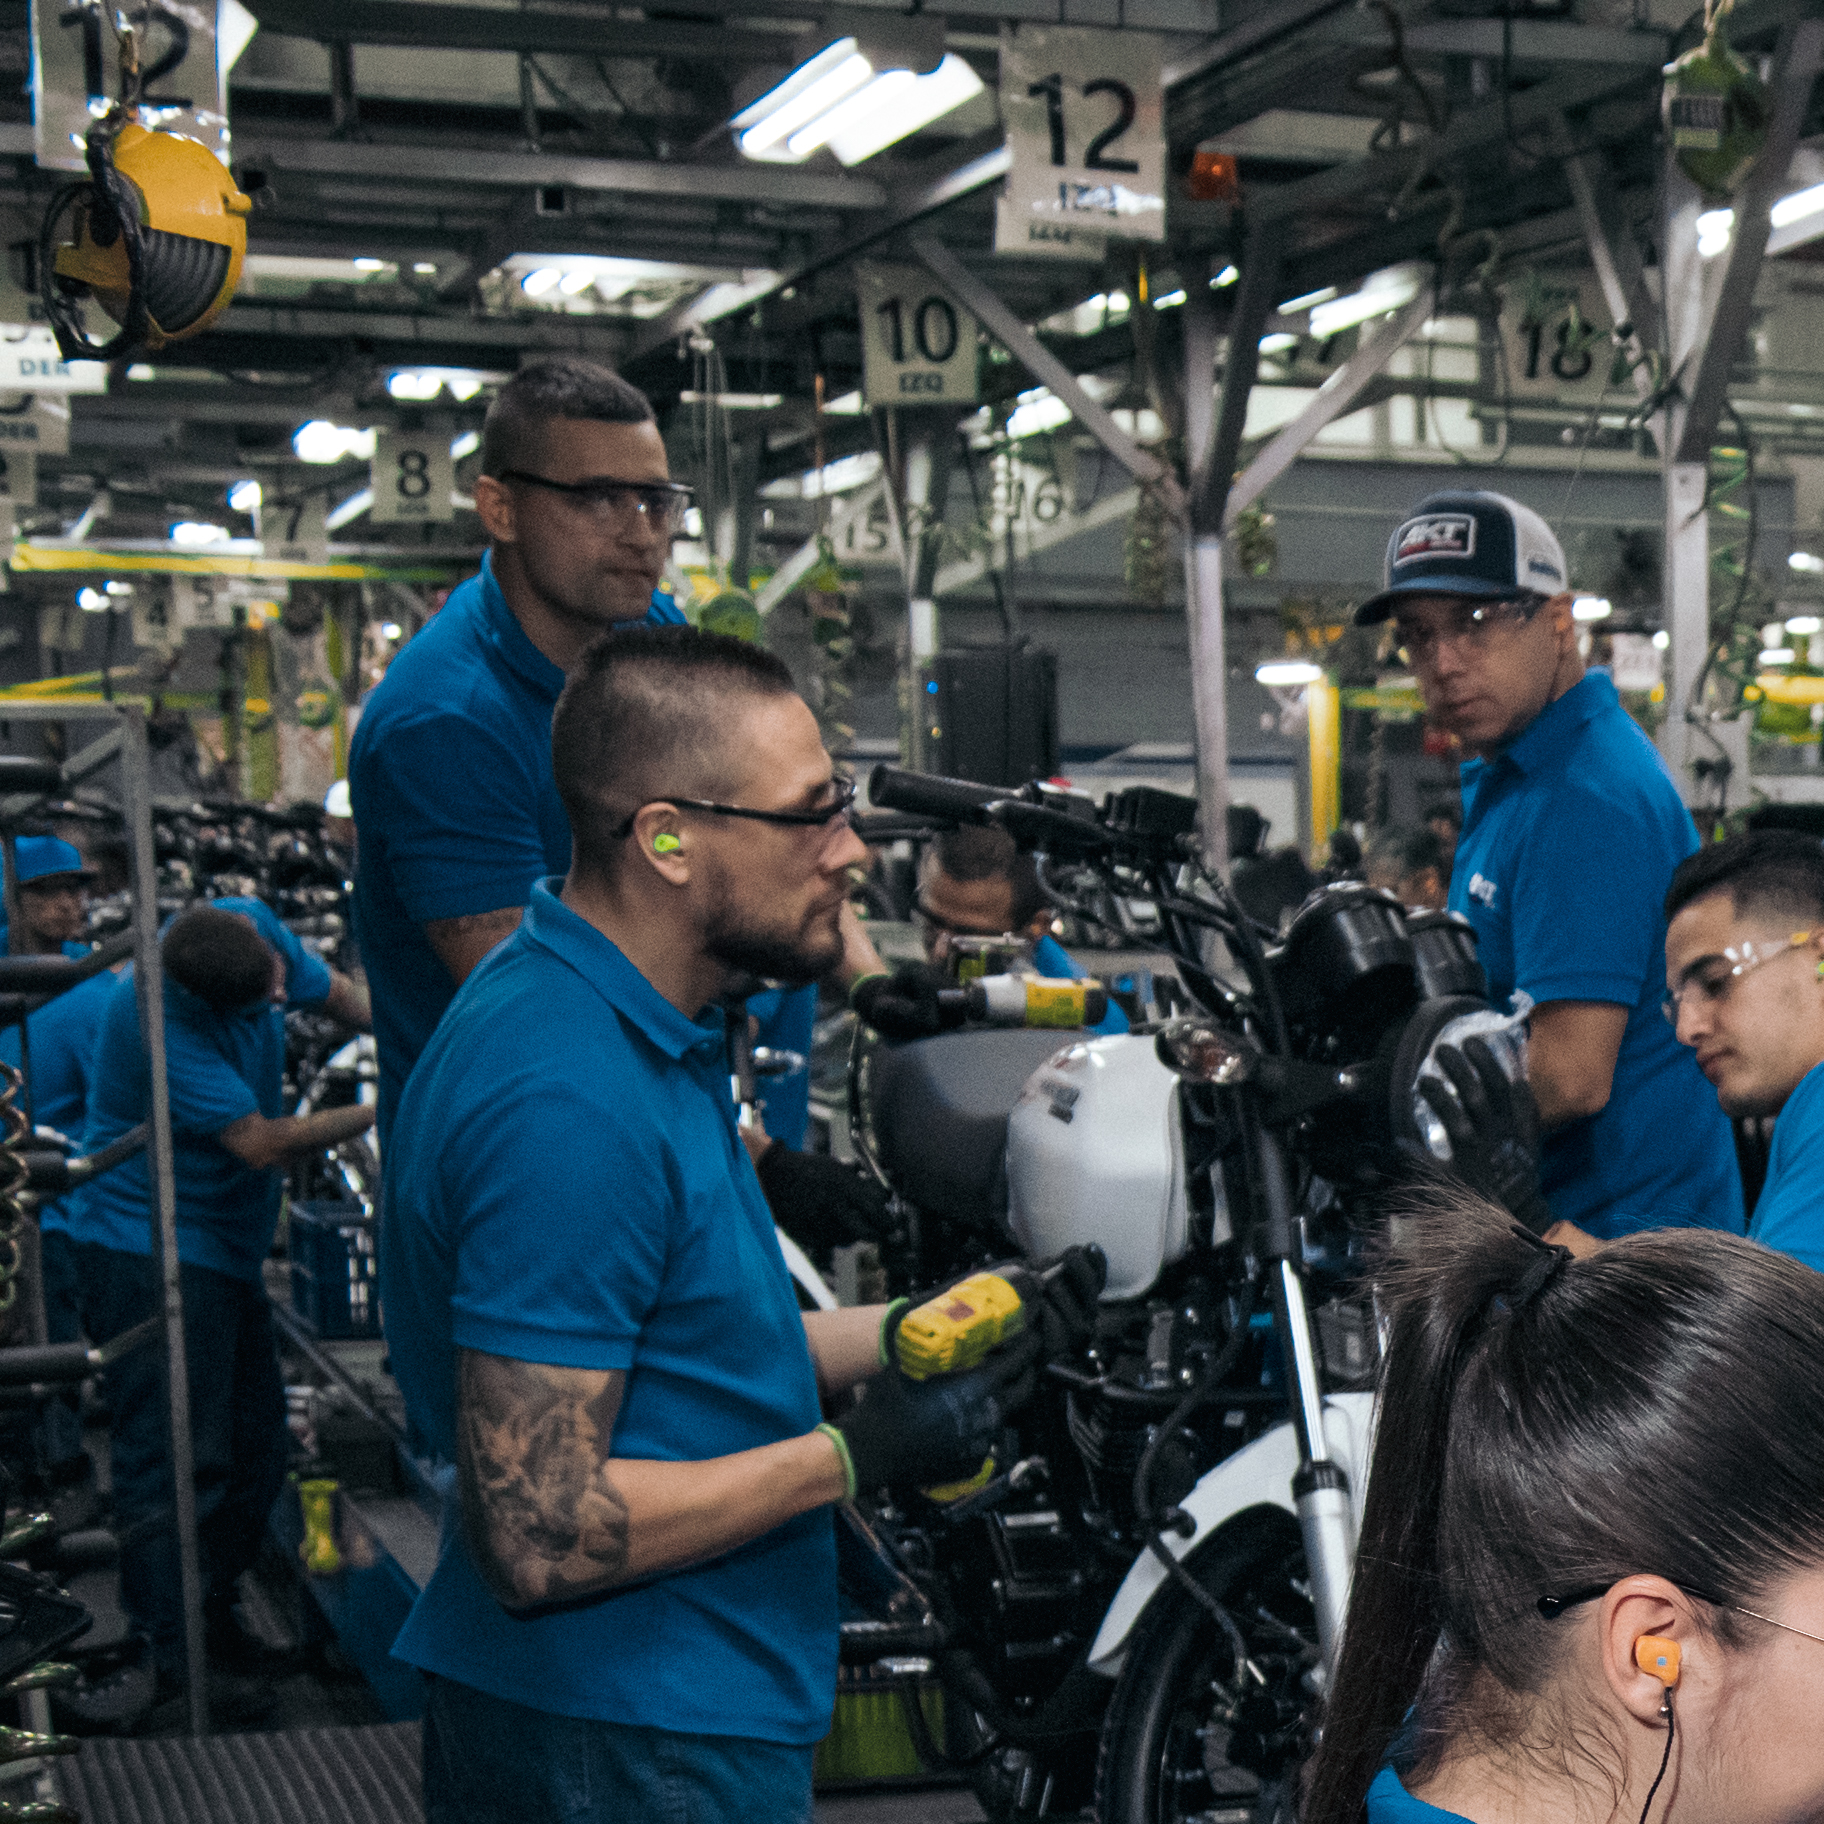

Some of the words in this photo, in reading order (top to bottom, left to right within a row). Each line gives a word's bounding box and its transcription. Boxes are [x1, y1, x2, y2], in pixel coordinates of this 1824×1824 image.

[58, 4, 193, 108] 12
[1027, 72, 1140, 174] 12
[876, 296, 958, 363] 10
[1519, 318, 1593, 381] 18
[395, 449, 431, 497] 8
